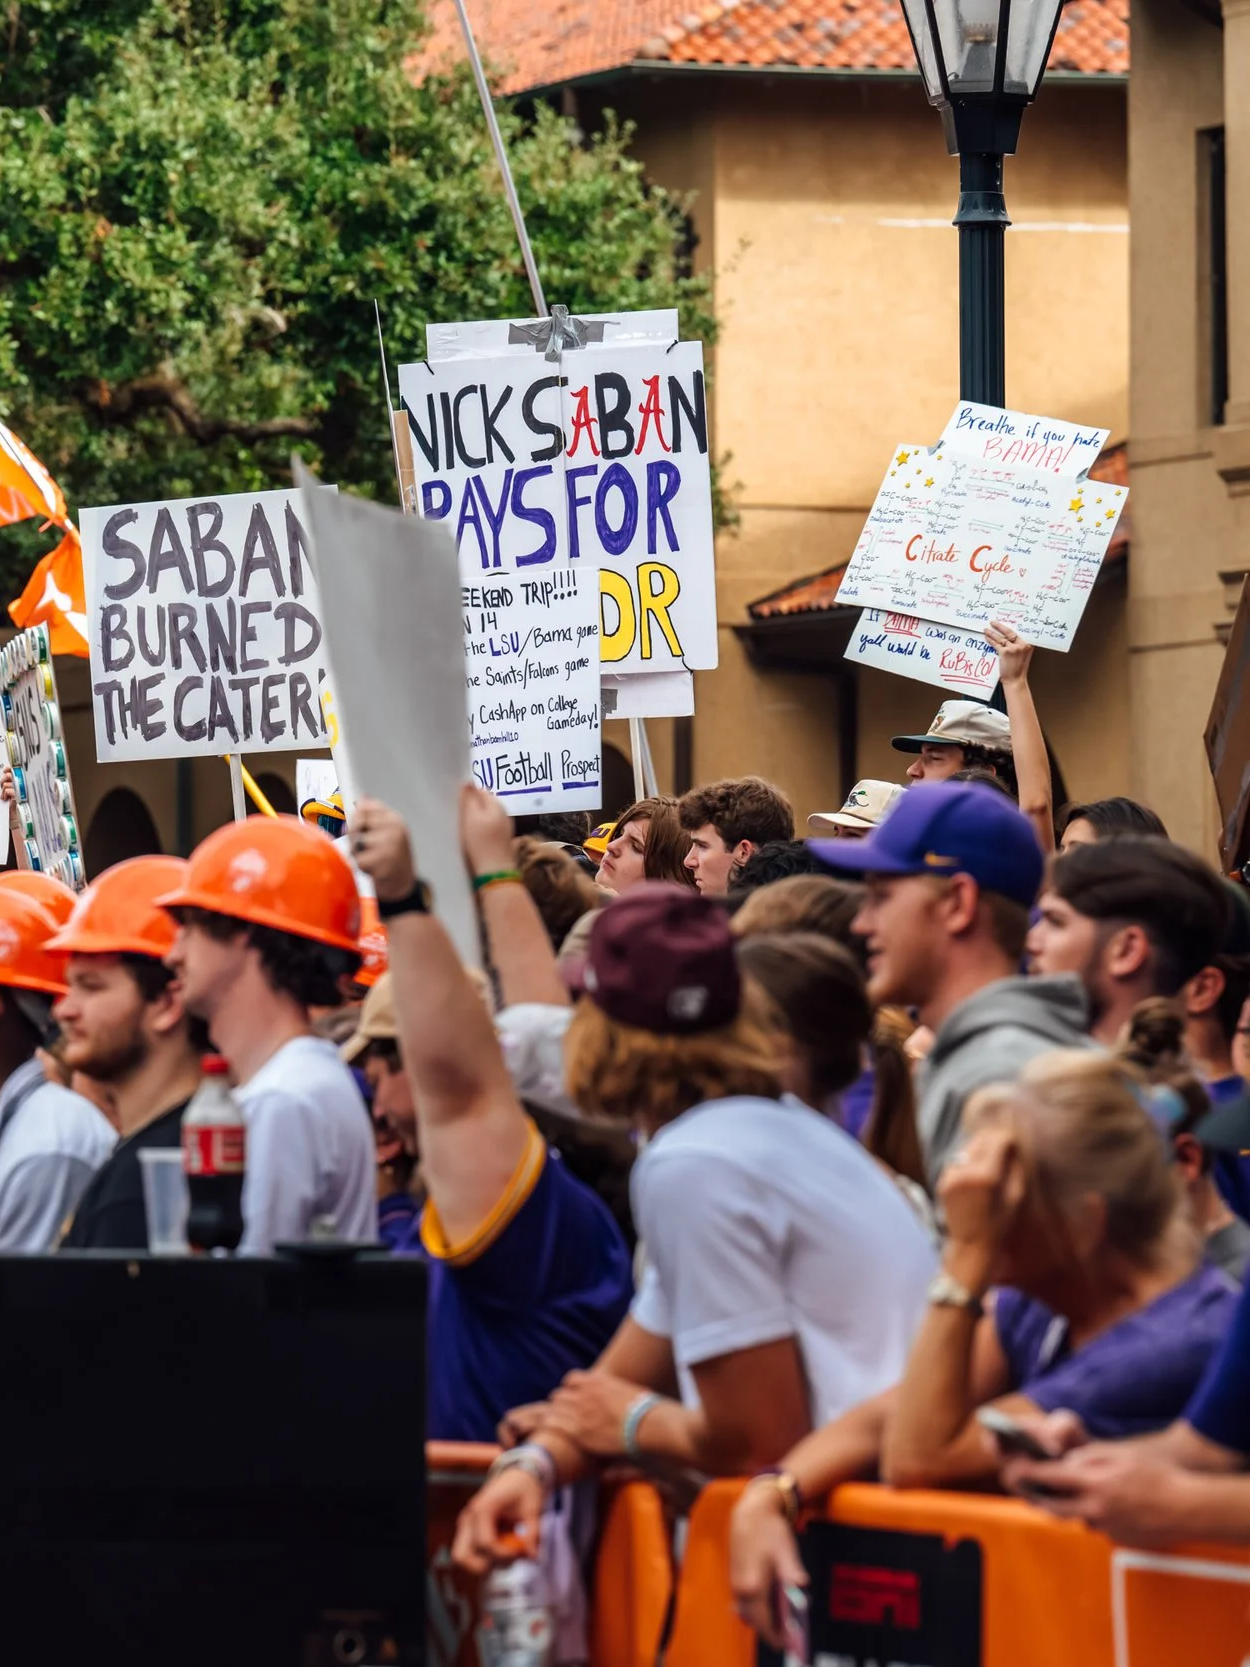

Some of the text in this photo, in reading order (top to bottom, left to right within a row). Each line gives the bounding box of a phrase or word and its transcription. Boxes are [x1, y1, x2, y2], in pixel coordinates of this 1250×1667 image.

[400, 369, 708, 473] NICK SABAN
[955, 407, 1100, 448] Breathe if you hate
[982, 436, 1075, 473] BAMA!
[421, 460, 681, 569] PAYS FOR
[905, 534, 962, 565] Citrate
[969, 545, 1015, 584] Cycle
[461, 586, 513, 608] EEKEND
[98, 596, 323, 676] BURNED
[481, 611, 498, 633] 14
[576, 624, 599, 649] game
[565, 657, 590, 681] game
[94, 672, 167, 746] THE
[530, 703, 545, 716] on
[547, 694, 578, 719] College
[546, 703, 599, 730] Gameday!
[472, 749, 600, 791] SU Football Prospect
